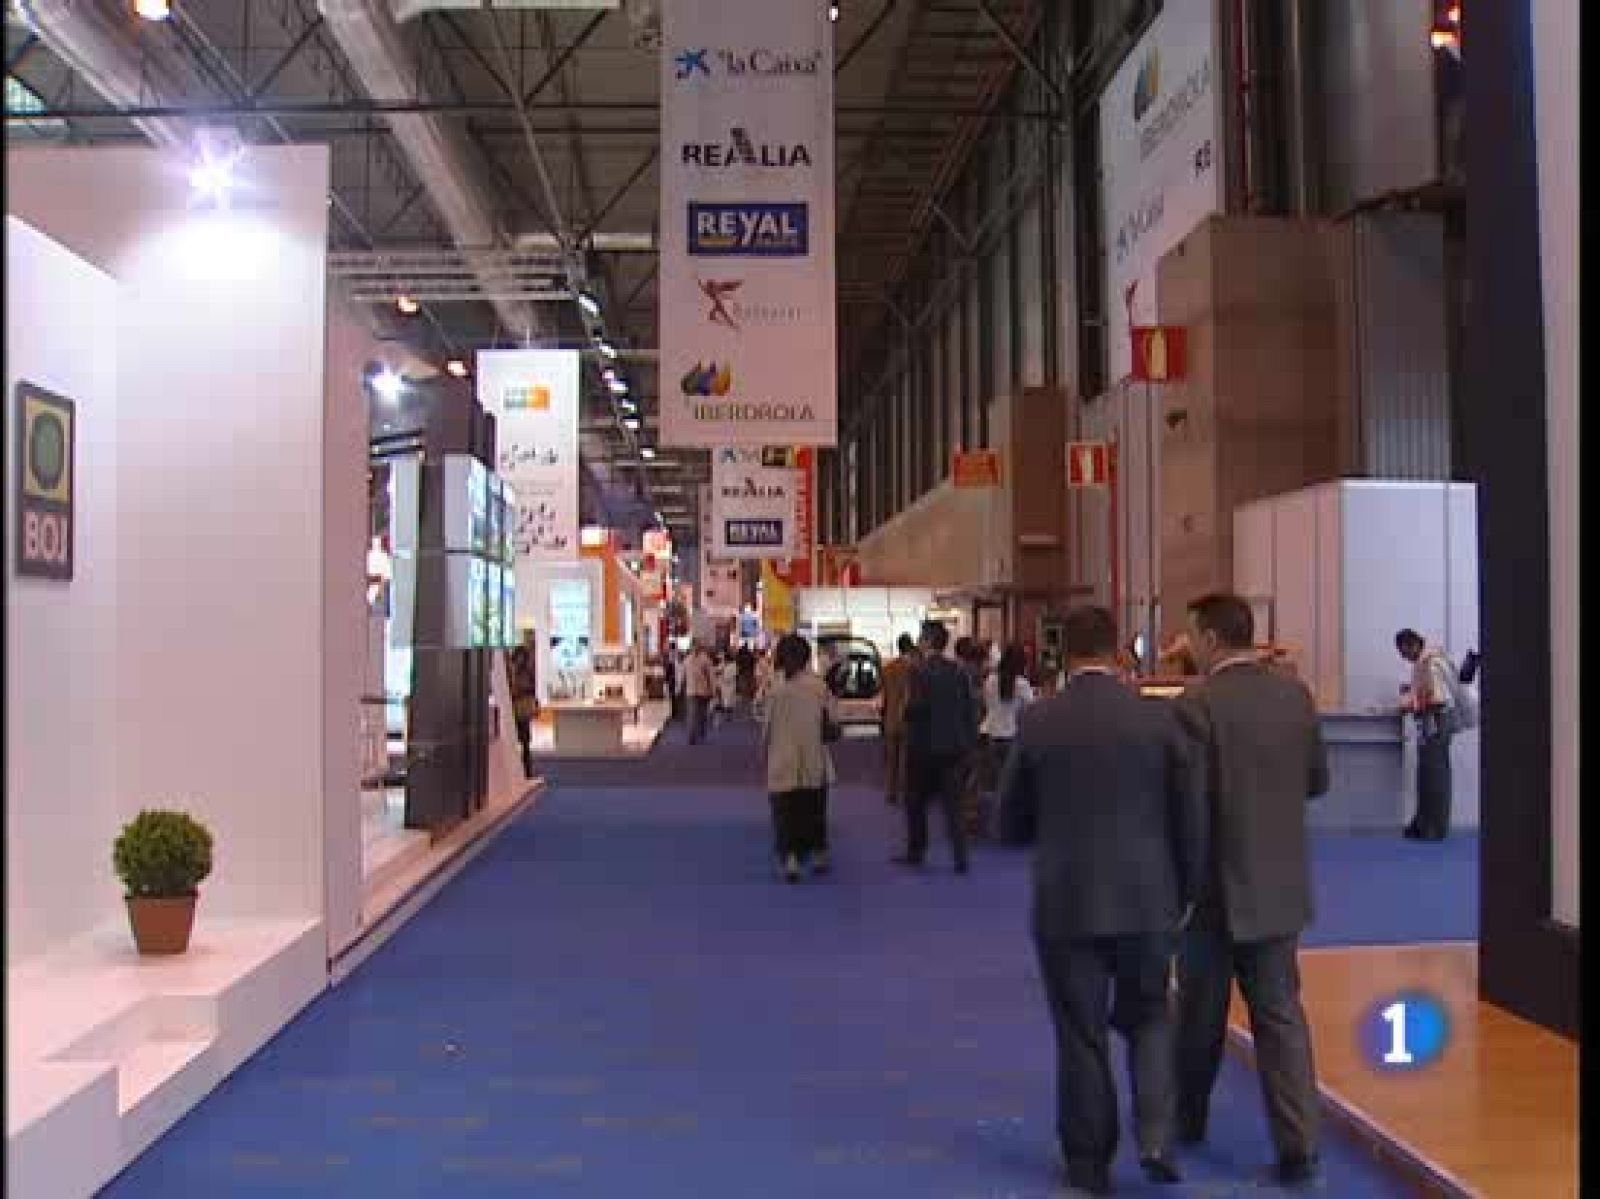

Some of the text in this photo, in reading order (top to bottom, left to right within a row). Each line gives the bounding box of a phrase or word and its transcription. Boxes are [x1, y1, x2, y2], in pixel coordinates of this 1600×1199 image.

[681, 127, 812, 167] REALIA
[697, 209, 798, 246] REYAL
[694, 402, 815, 420] IBERDROLA
